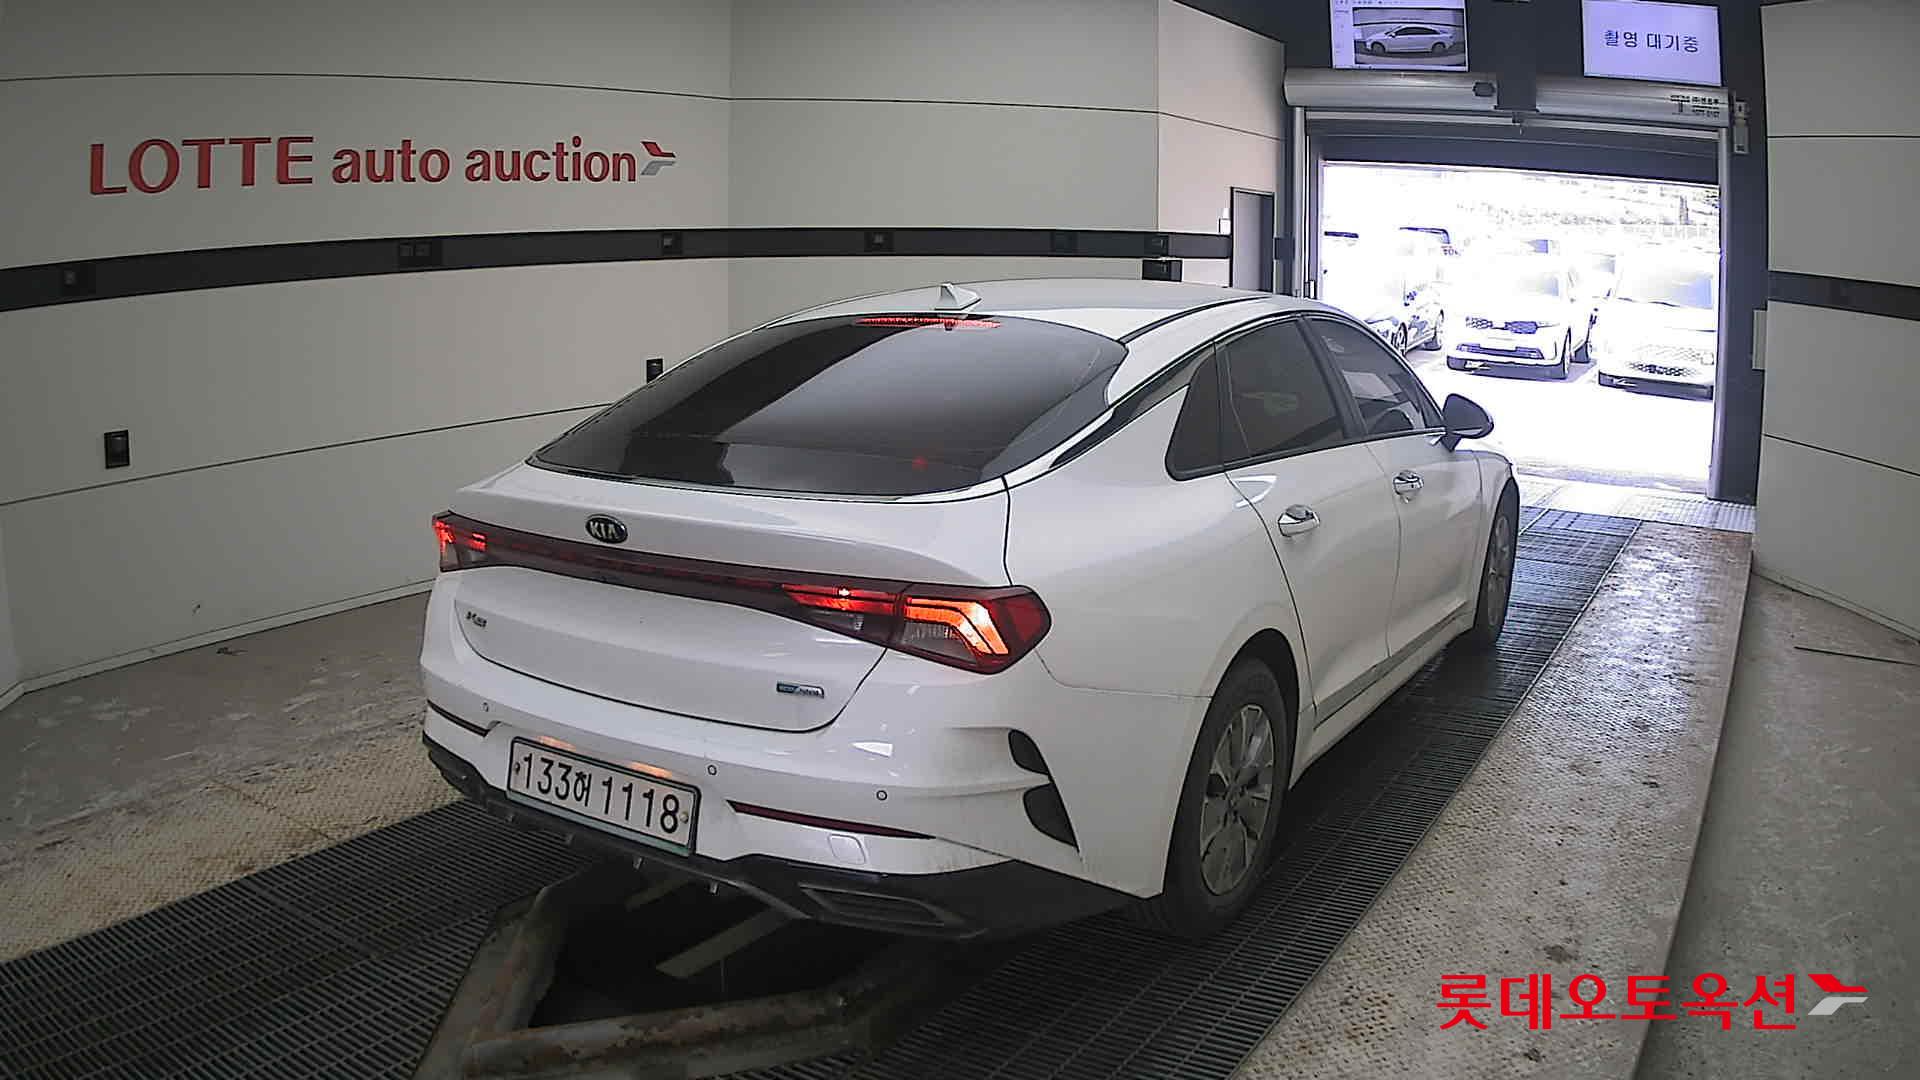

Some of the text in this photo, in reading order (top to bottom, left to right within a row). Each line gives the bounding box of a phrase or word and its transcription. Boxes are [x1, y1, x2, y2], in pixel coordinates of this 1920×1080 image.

[1646, 33, 1698, 53] 대기중
[90, 136, 637, 195] LOTTE auto auction
[590, 520, 620, 540] KIA
[602, 776, 680, 834] 1118
